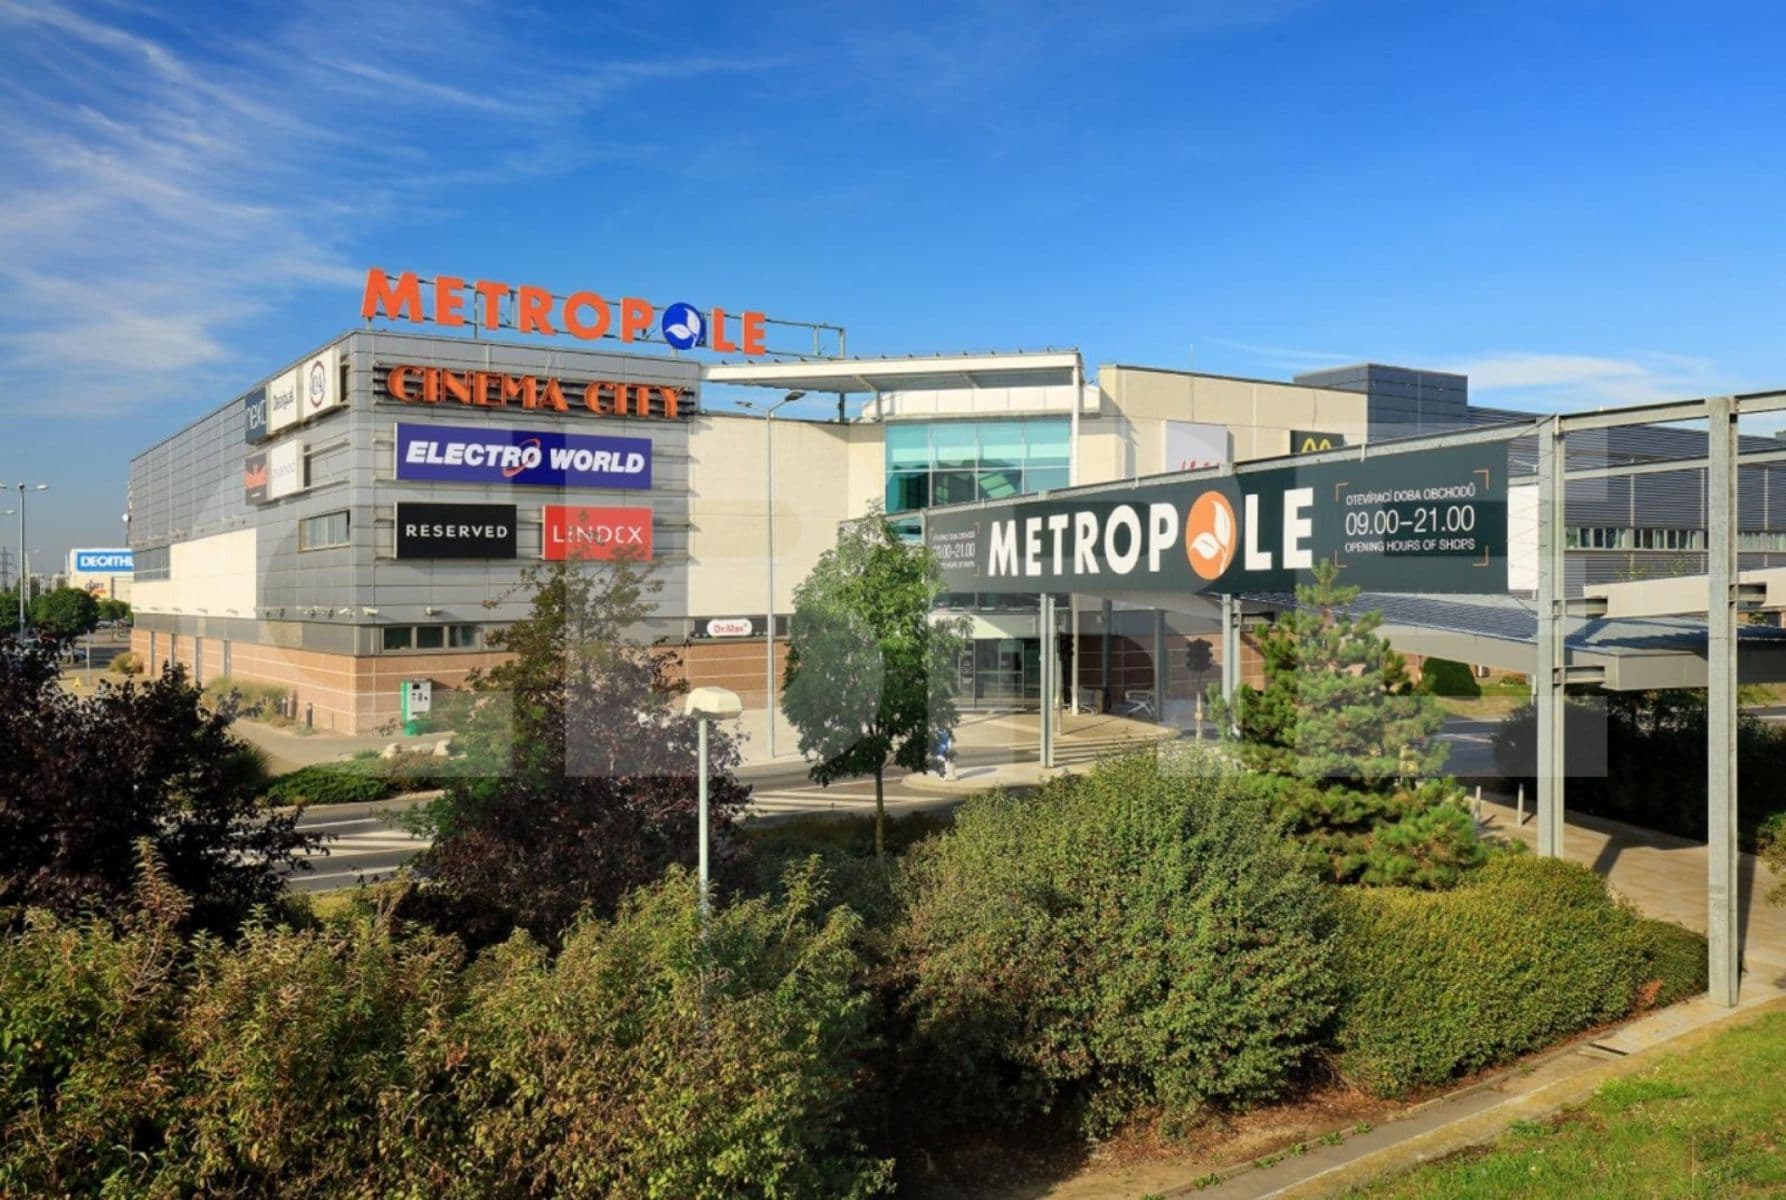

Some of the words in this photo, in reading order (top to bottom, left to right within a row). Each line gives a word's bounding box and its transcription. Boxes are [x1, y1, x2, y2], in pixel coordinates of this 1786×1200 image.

[386, 365, 569, 412] CINEMA
[584, 381, 685, 418] CITY
[405, 439, 542, 470] ELECTRO
[550, 449, 646, 474] WORLD
[1394, 488, 1421, 502] DOBA
[406, 523, 508, 539] RESERVED
[552, 524, 643, 545] LINDEX
[1344, 541, 1384, 553] OPENING
[1386, 540, 1420, 552] HOURS
[1423, 539, 1436, 551] OF
[1439, 538, 1476, 551] SHOPS
